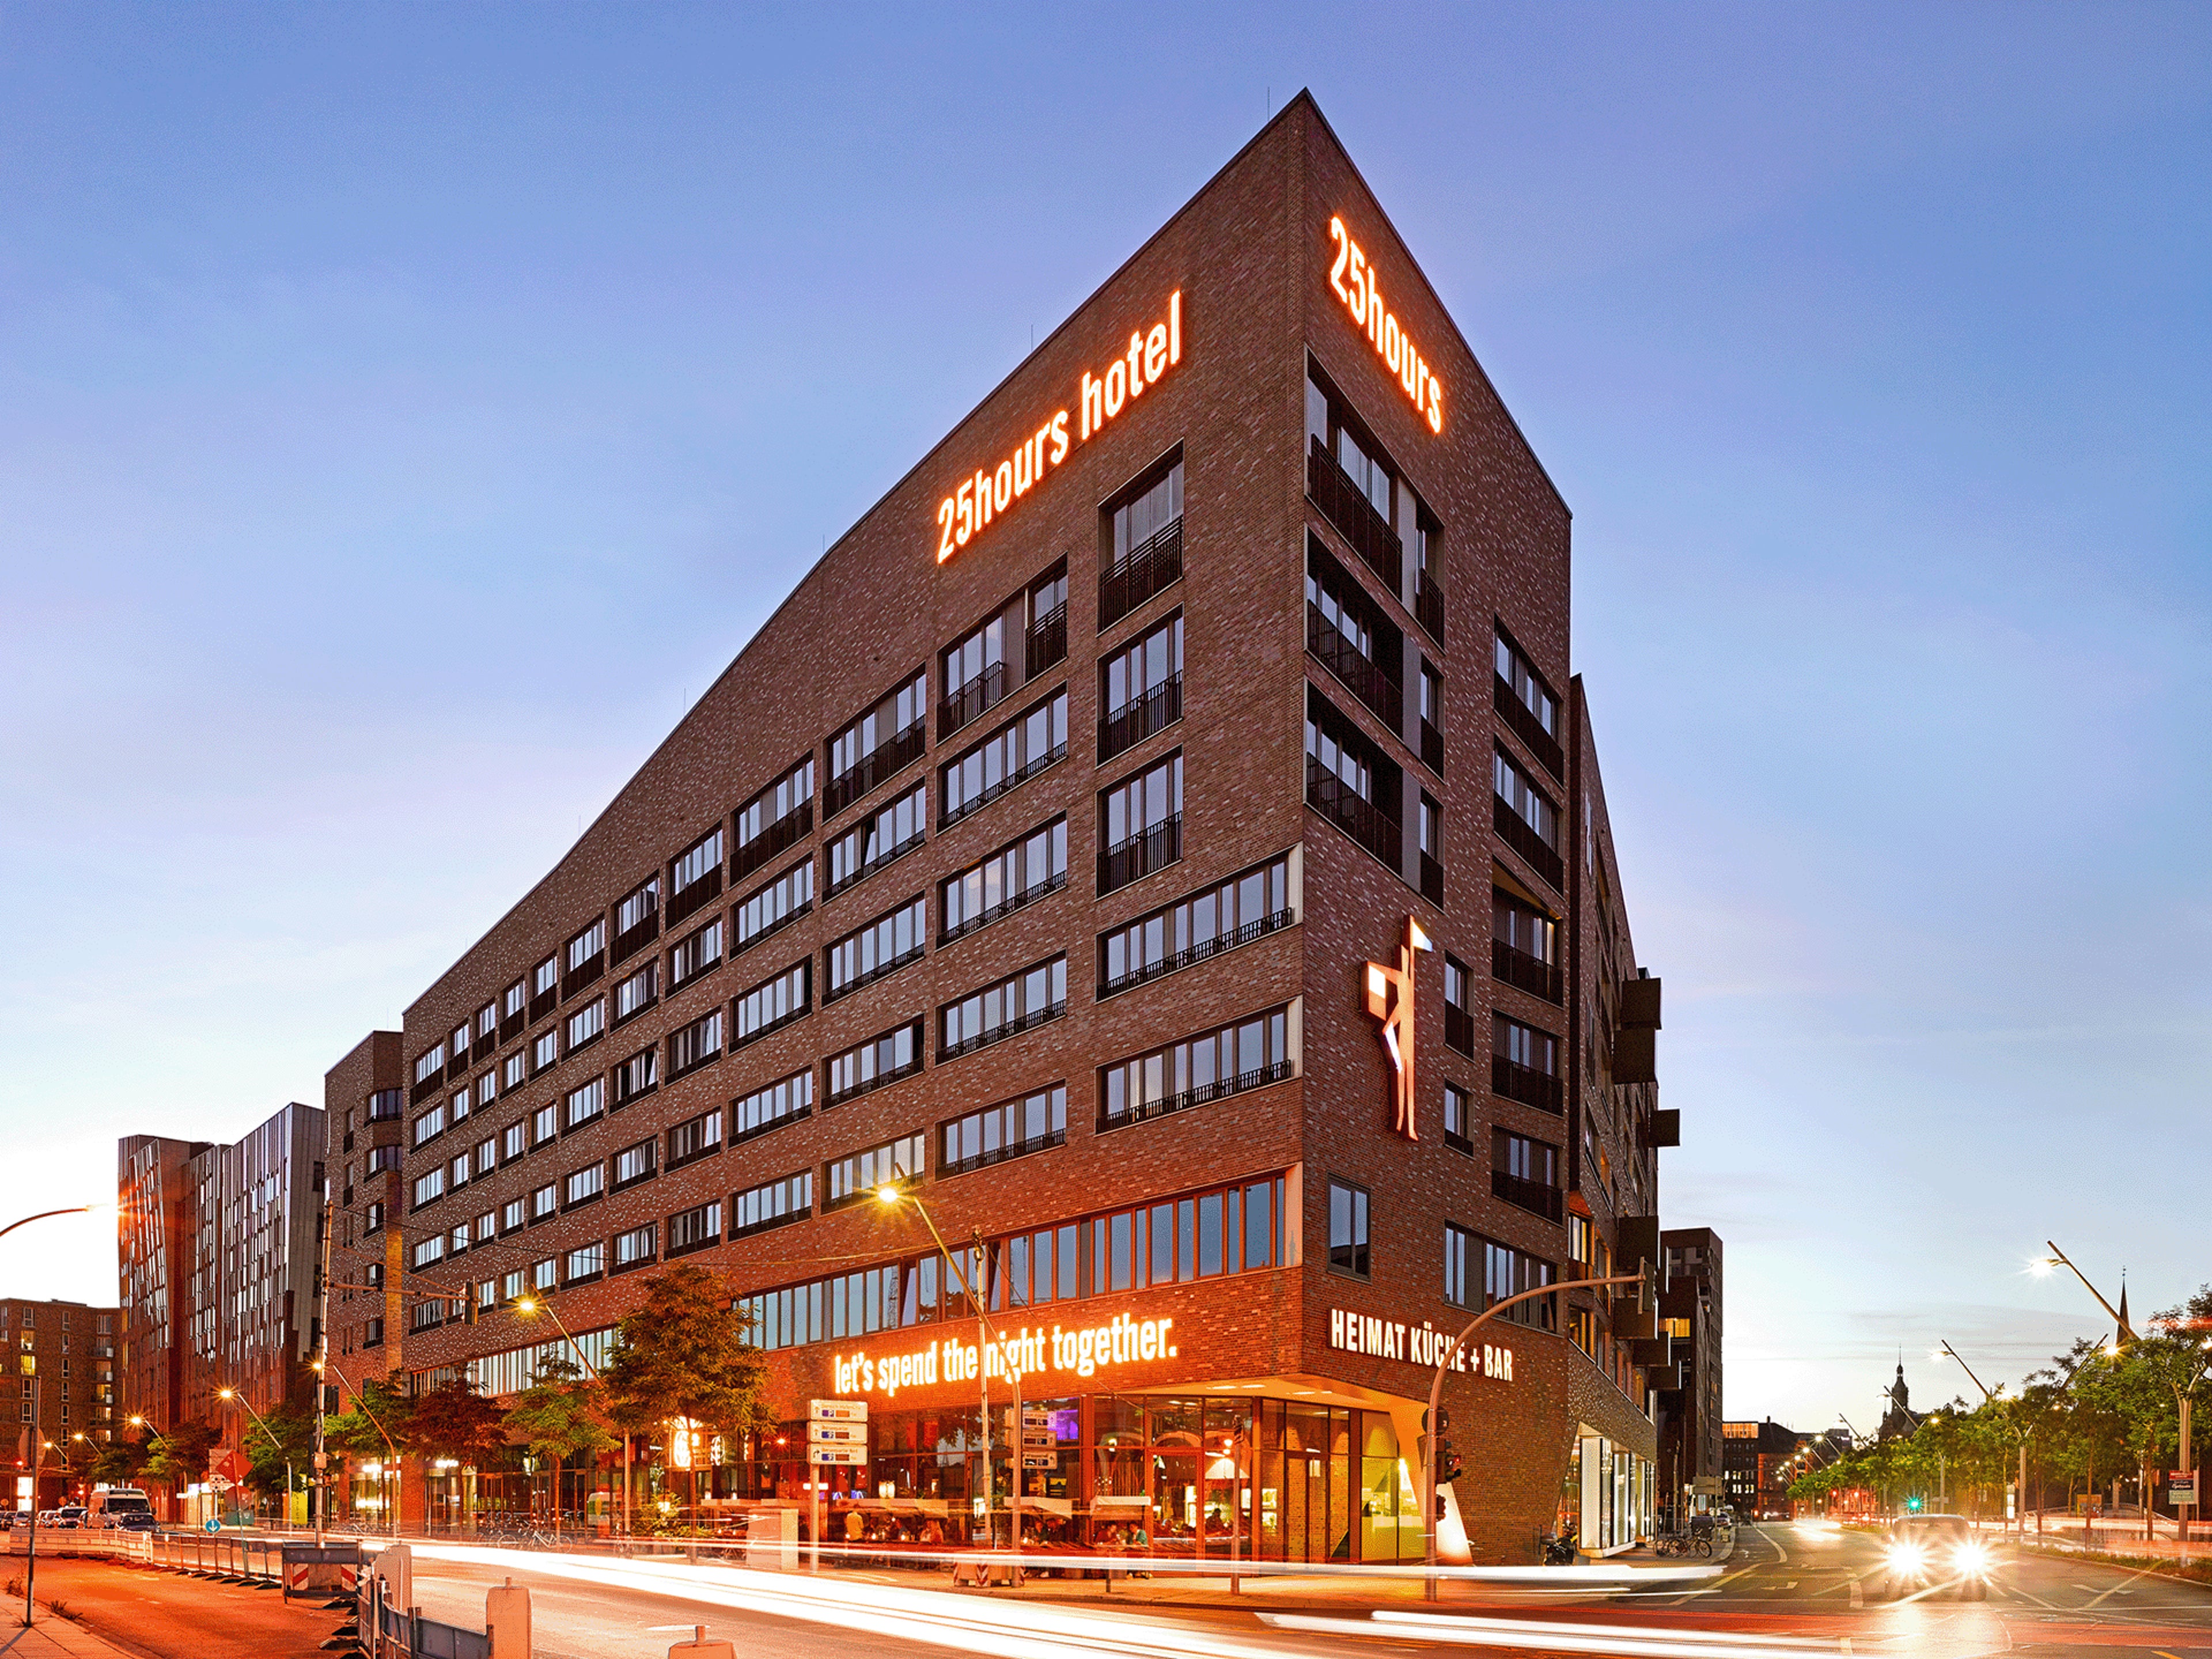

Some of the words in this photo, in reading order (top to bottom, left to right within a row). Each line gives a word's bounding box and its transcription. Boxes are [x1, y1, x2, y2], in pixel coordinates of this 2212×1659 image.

[1331, 217, 1441, 433] 25hours
[938, 410, 1069, 564] 25hours
[1082, 290, 1181, 440] hotel
[835, 1352, 874, 1394] let's
[878, 1341, 937, 1397] spend
[942, 1338, 978, 1382] the
[986, 1328, 1046, 1384] night
[1052, 1313, 1177, 1376] together.
[1331, 1309, 1406, 1360] HEIMAT
[1411, 1321, 1465, 1372] KÜCHE
[1470, 1348, 1480, 1372] +
[1484, 1344, 1513, 1381] BAR
